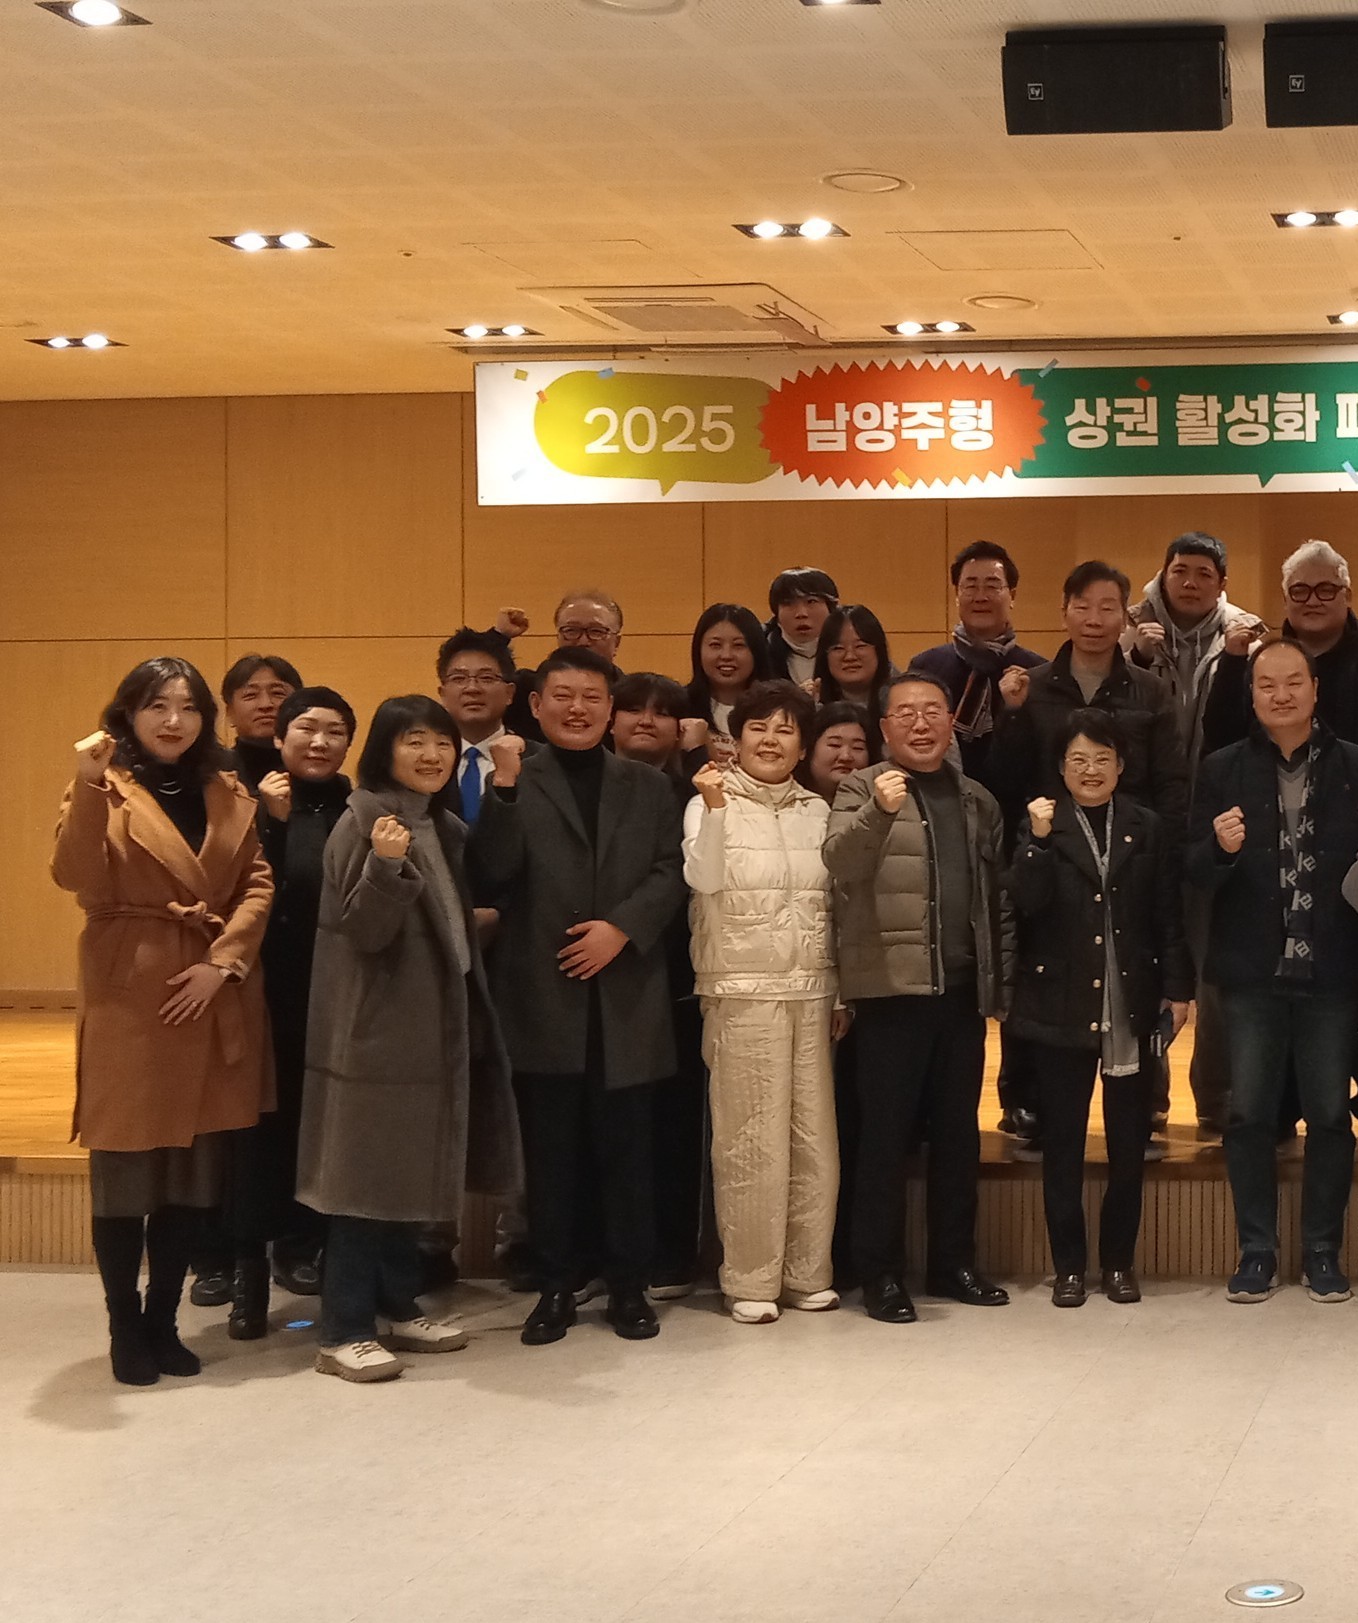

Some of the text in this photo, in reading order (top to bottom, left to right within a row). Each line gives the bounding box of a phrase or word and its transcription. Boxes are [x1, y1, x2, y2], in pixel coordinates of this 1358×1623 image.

[584, 404, 735, 454] 2025
[804, 399, 995, 452] 남양주형
[1065, 396, 1159, 448] 상권
[1175, 391, 1321, 446] 활성화
